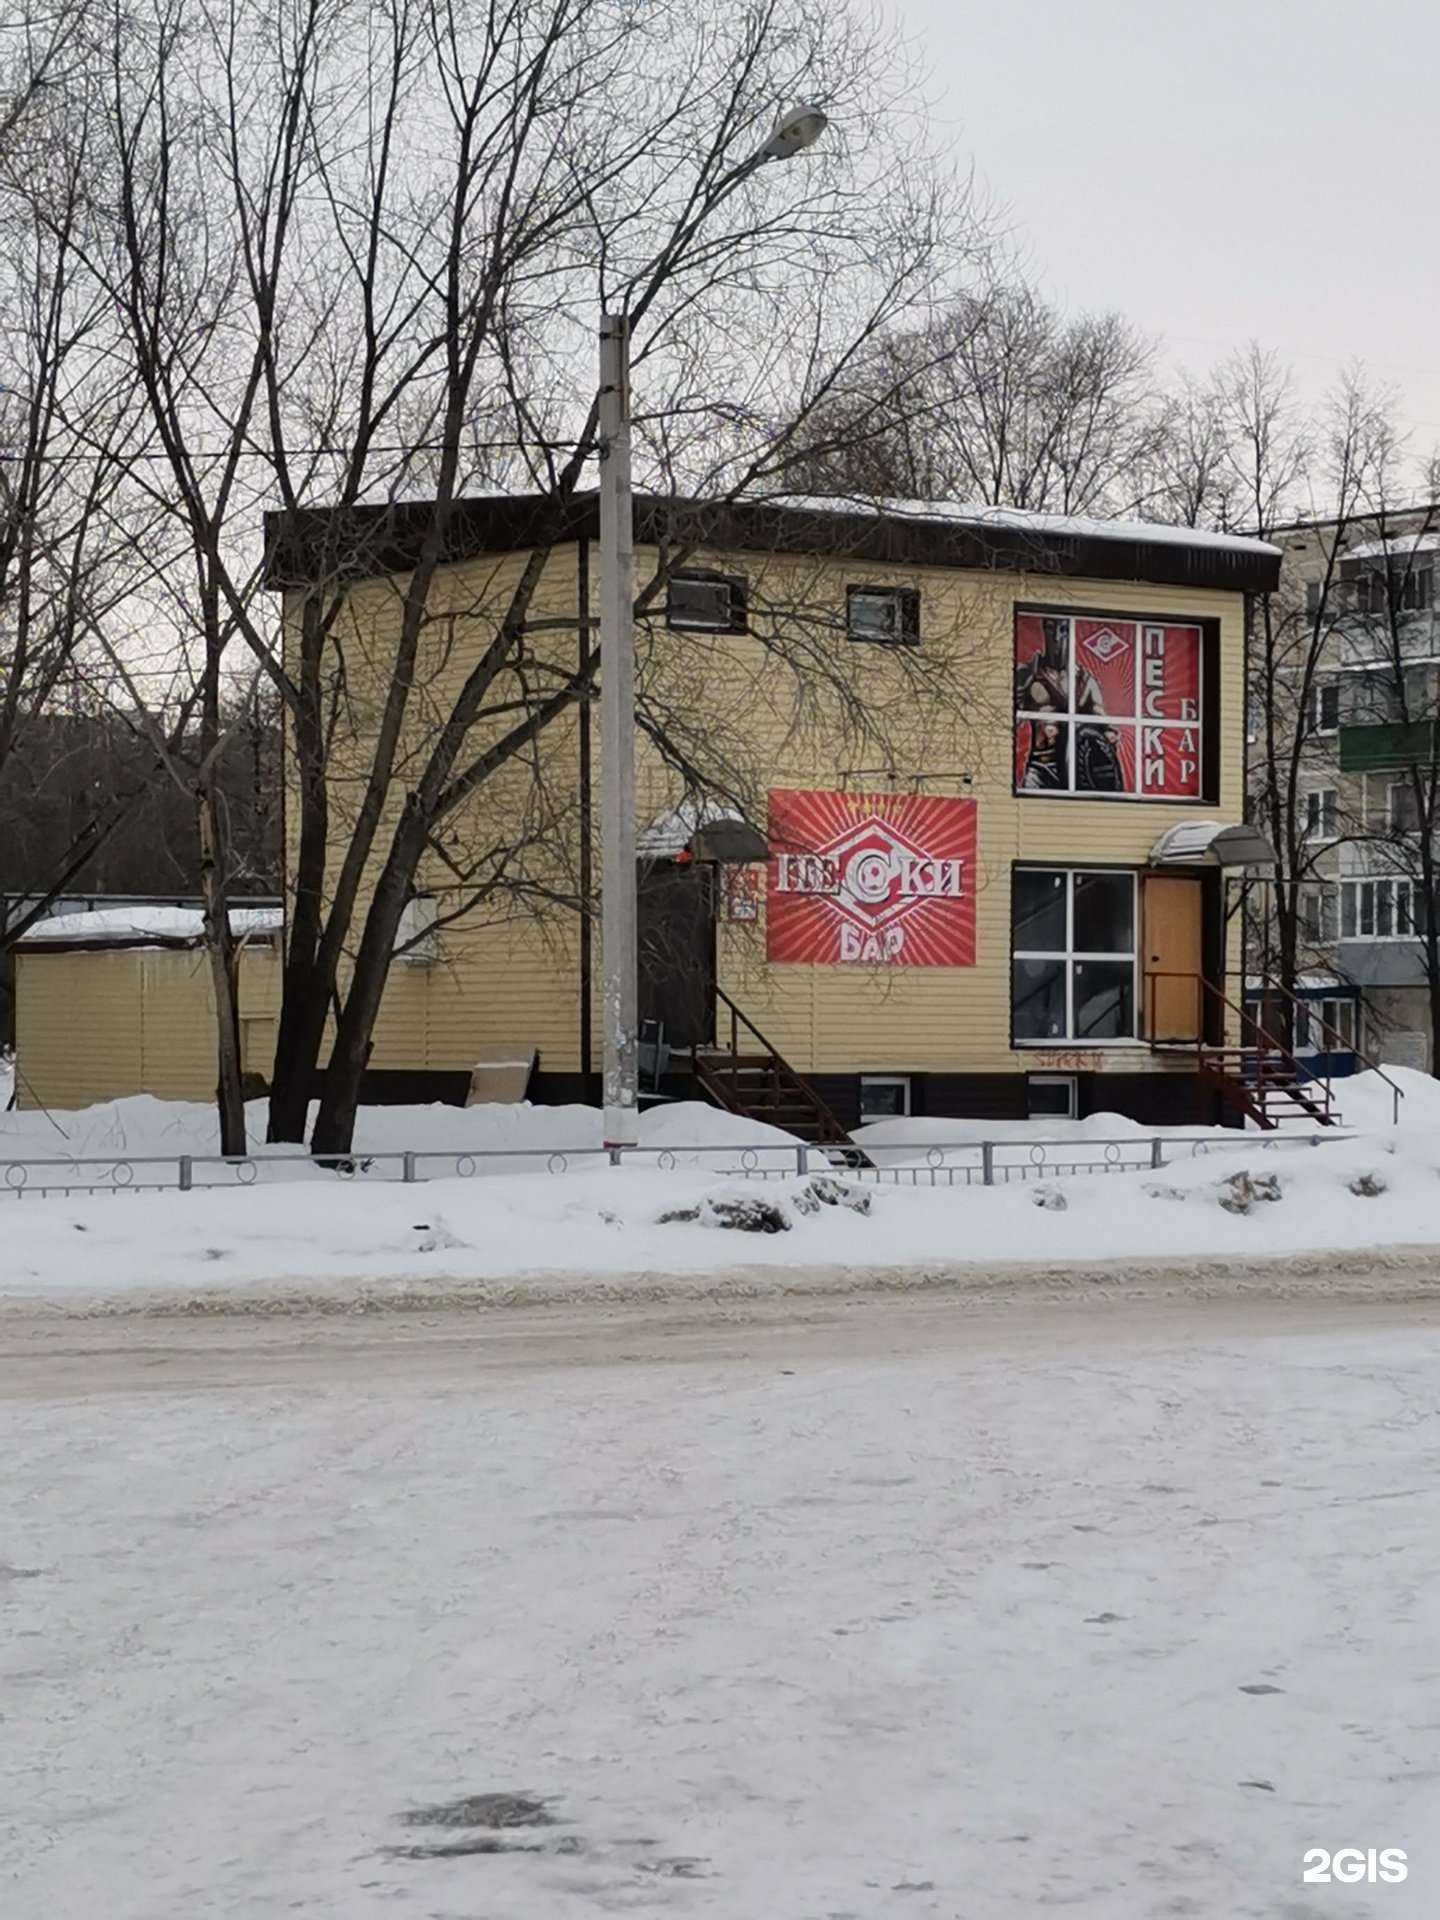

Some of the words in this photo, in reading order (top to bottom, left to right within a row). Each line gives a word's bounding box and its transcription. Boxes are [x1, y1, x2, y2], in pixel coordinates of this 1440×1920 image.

[1145, 627, 1165, 787] ПЕСКИ
[1179, 698, 1197, 784] БАР
[775, 849, 966, 903] ПЕСКИ
[840, 922, 905, 961] БАР
